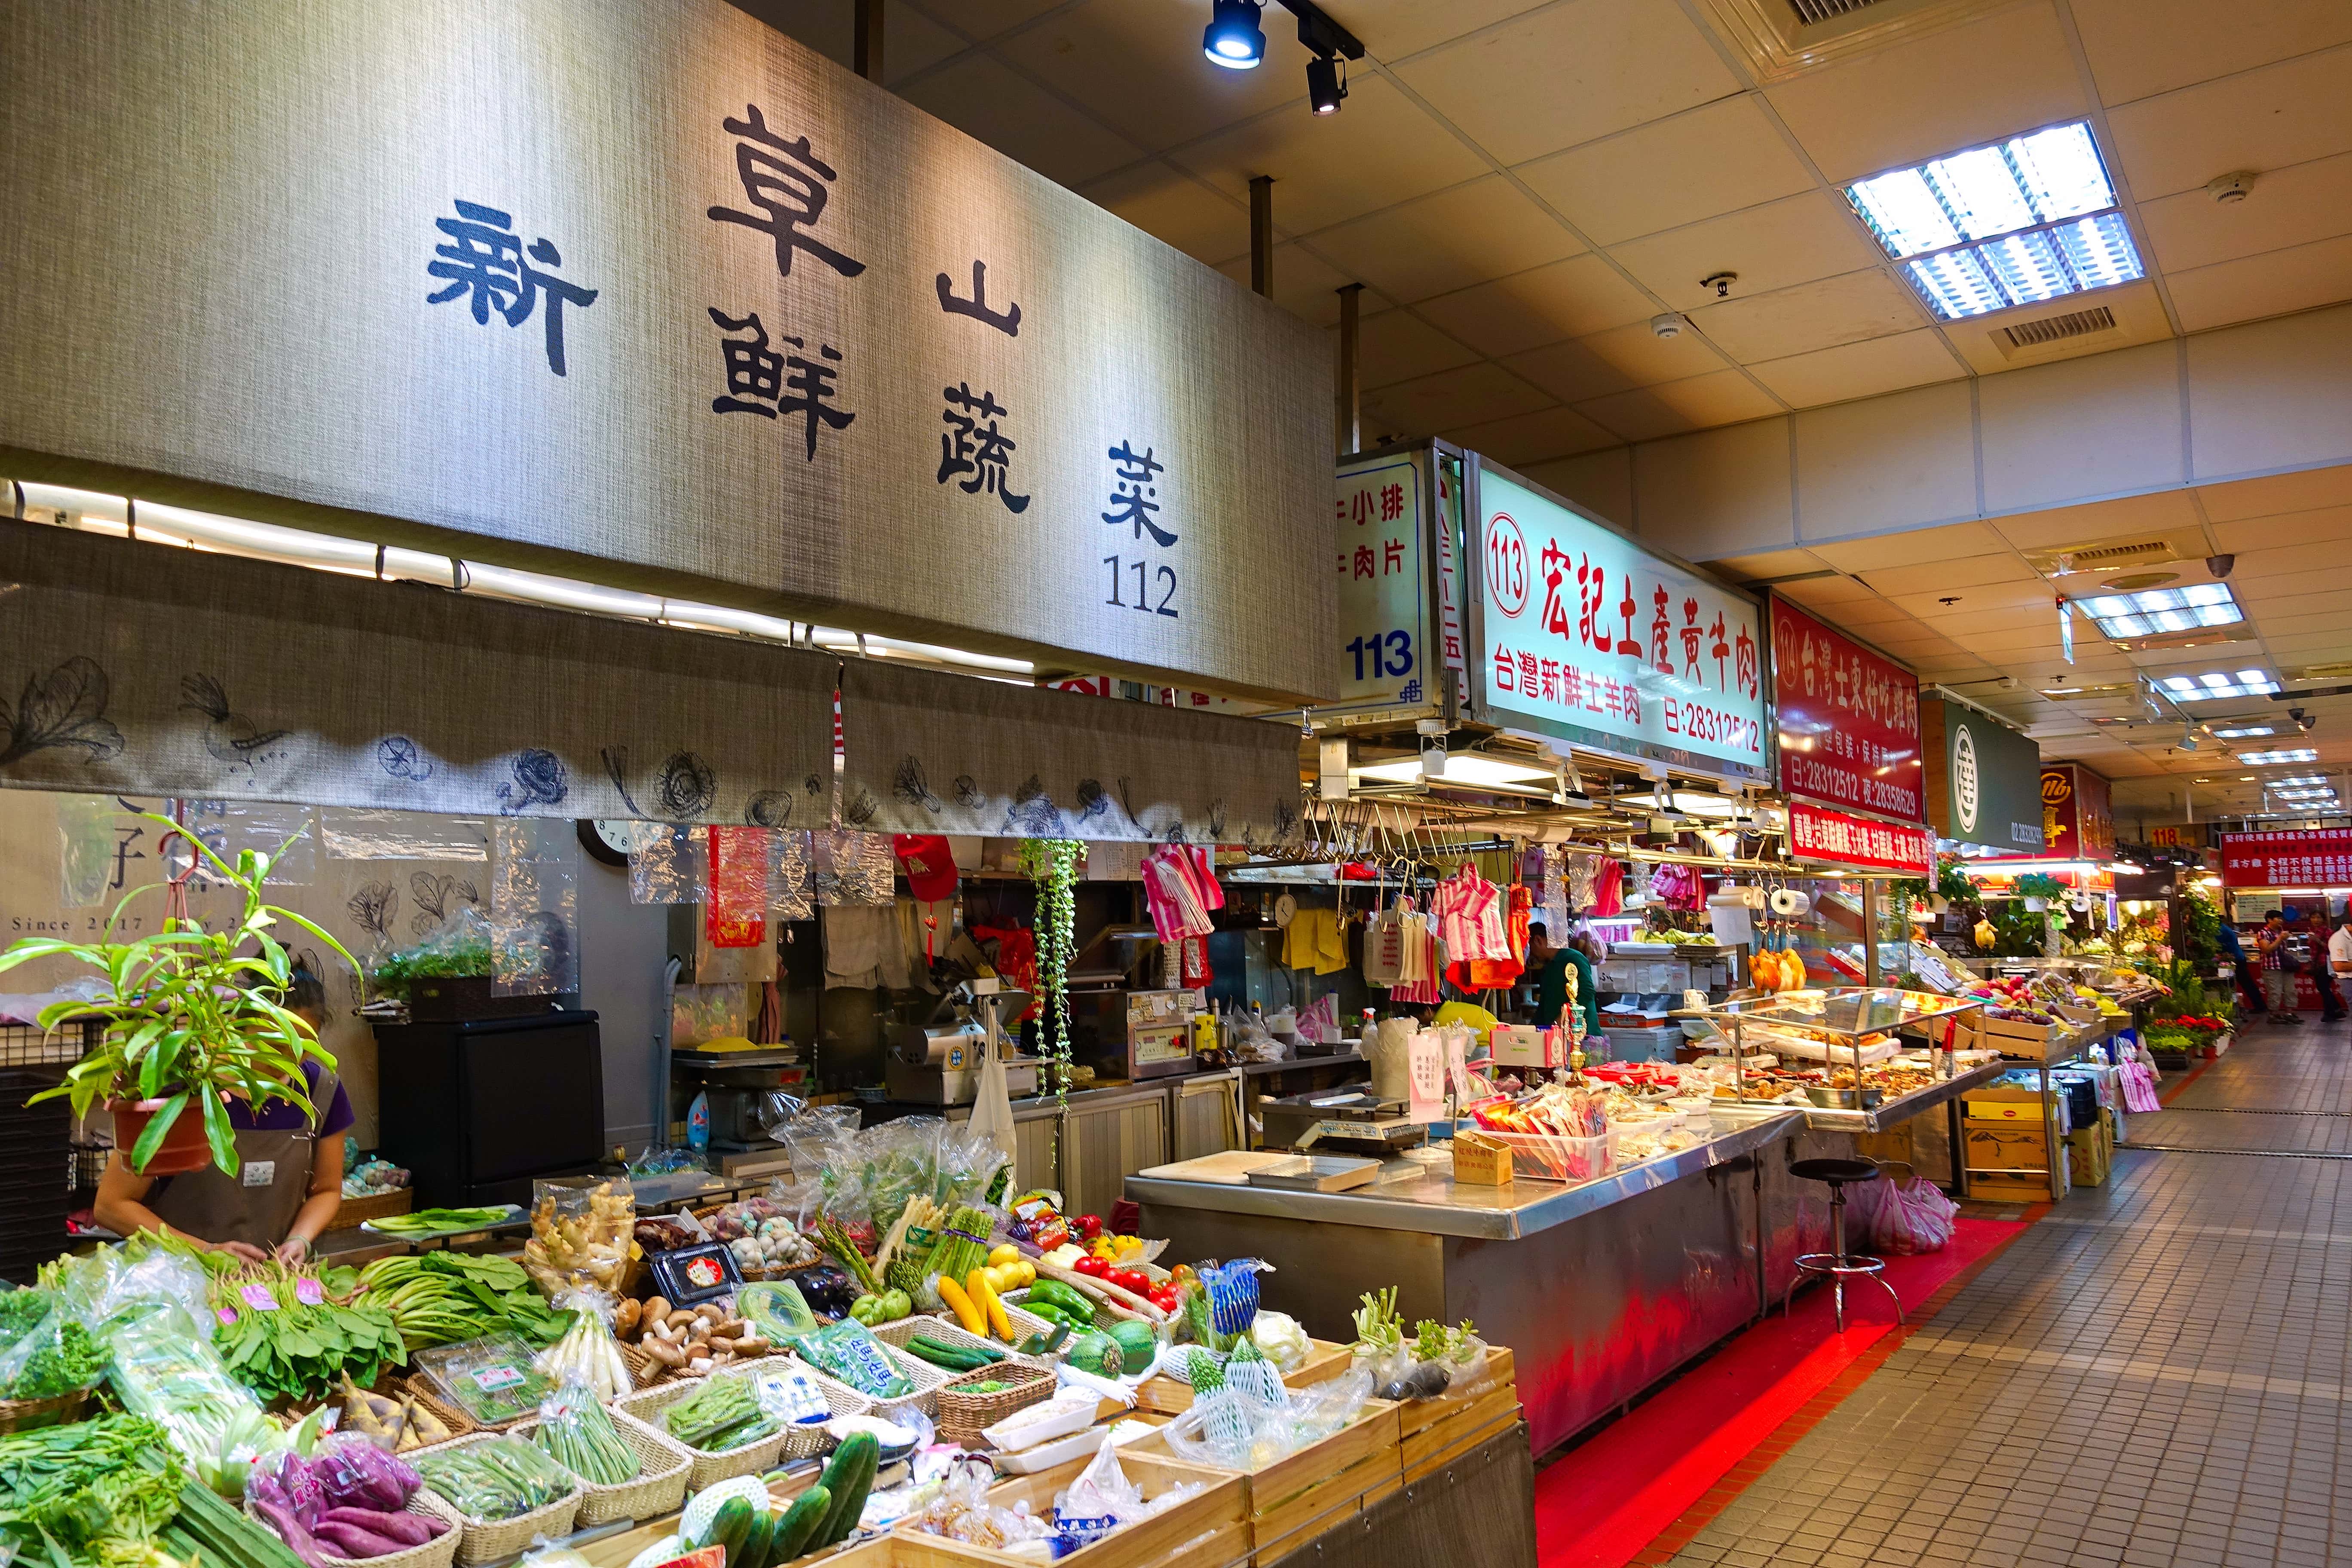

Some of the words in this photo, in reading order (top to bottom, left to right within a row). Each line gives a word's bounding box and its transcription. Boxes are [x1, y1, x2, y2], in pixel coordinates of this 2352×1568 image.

[1490, 529, 1523, 599] 113
[1104, 555, 1179, 618] 112
[1541, 537, 1757, 701] 宏記土產黃牛肉
[1346, 630, 1413, 681] 113
[1494, 643, 1641, 725] 台灣新鮮土羊肉
[1791, 755, 1859, 802] 日:28312512
[599, 820, 605, 830] 8
[609, 832, 616, 841] 7
[621, 836, 628, 846] 6
[2153, 827, 2177, 846] 118
[2225, 830, 2352, 843] 堅持使用業界最高品質優質
[12, 917, 70, 931] Since
[87, 917, 142, 931] 2017
